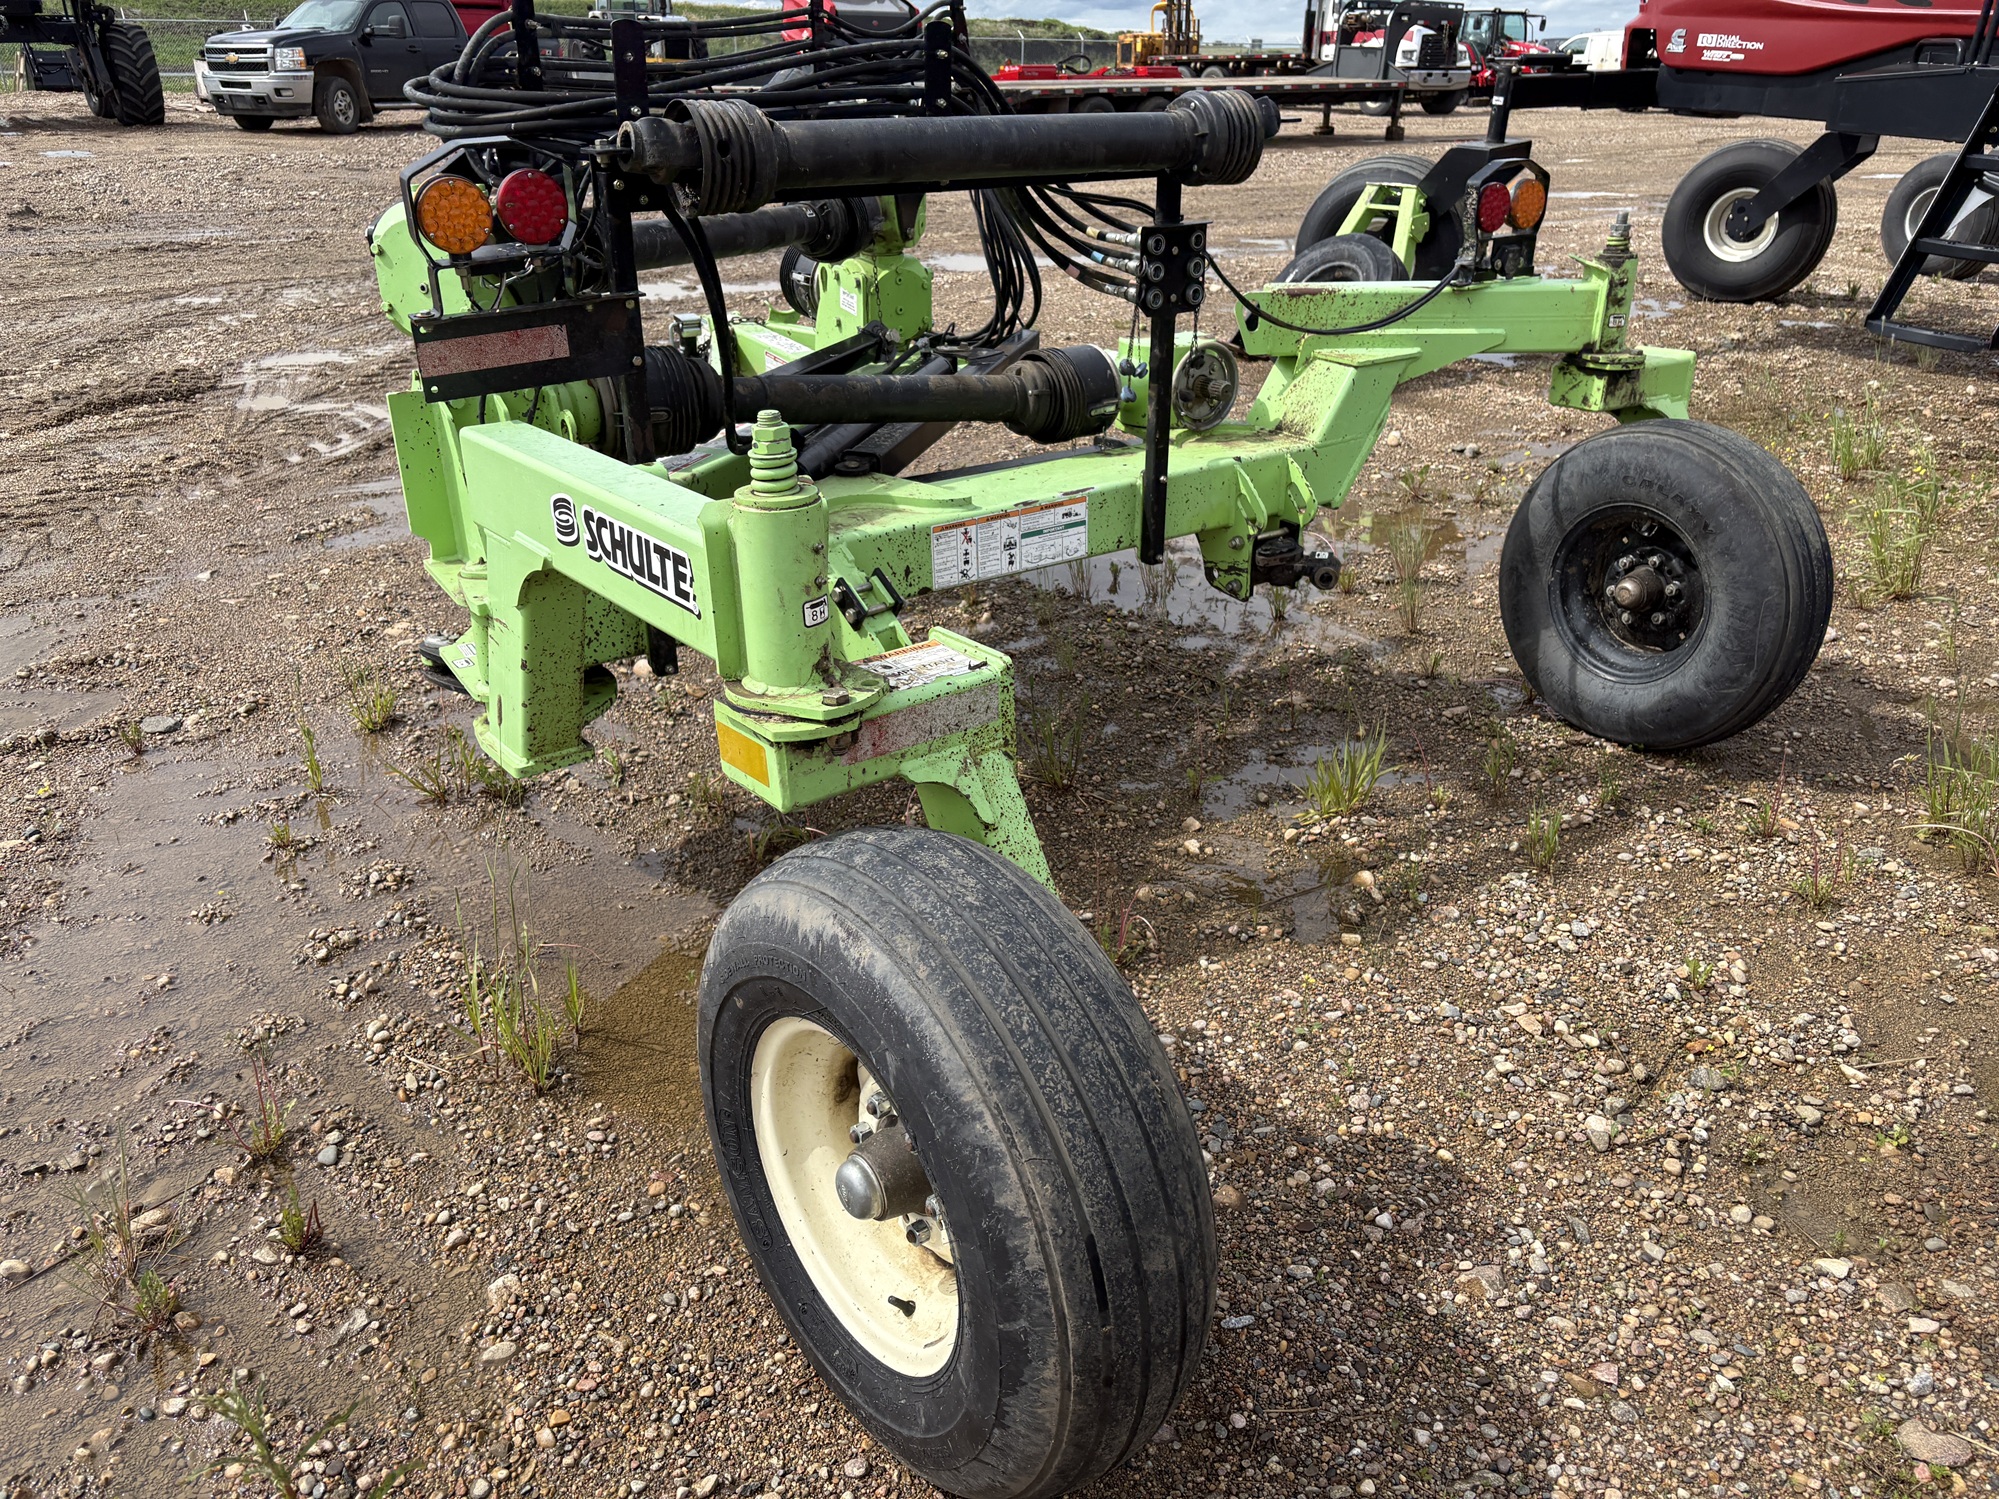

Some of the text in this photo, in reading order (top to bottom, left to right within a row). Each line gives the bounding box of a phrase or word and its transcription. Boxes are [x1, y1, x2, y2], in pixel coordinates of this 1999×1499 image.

[1718, 34, 1741, 42] DUAL
[1716, 39, 1764, 50] DIRECTION
[989, 513, 1011, 522] WARNING
[944, 522, 966, 531] WARNING
[1042, 525, 1065, 534] IMPORTANT
[582, 508, 694, 604] SCHULTE
[753, 954, 808, 982] PROTECTION
[722, 1122, 769, 1240] SAMSON
